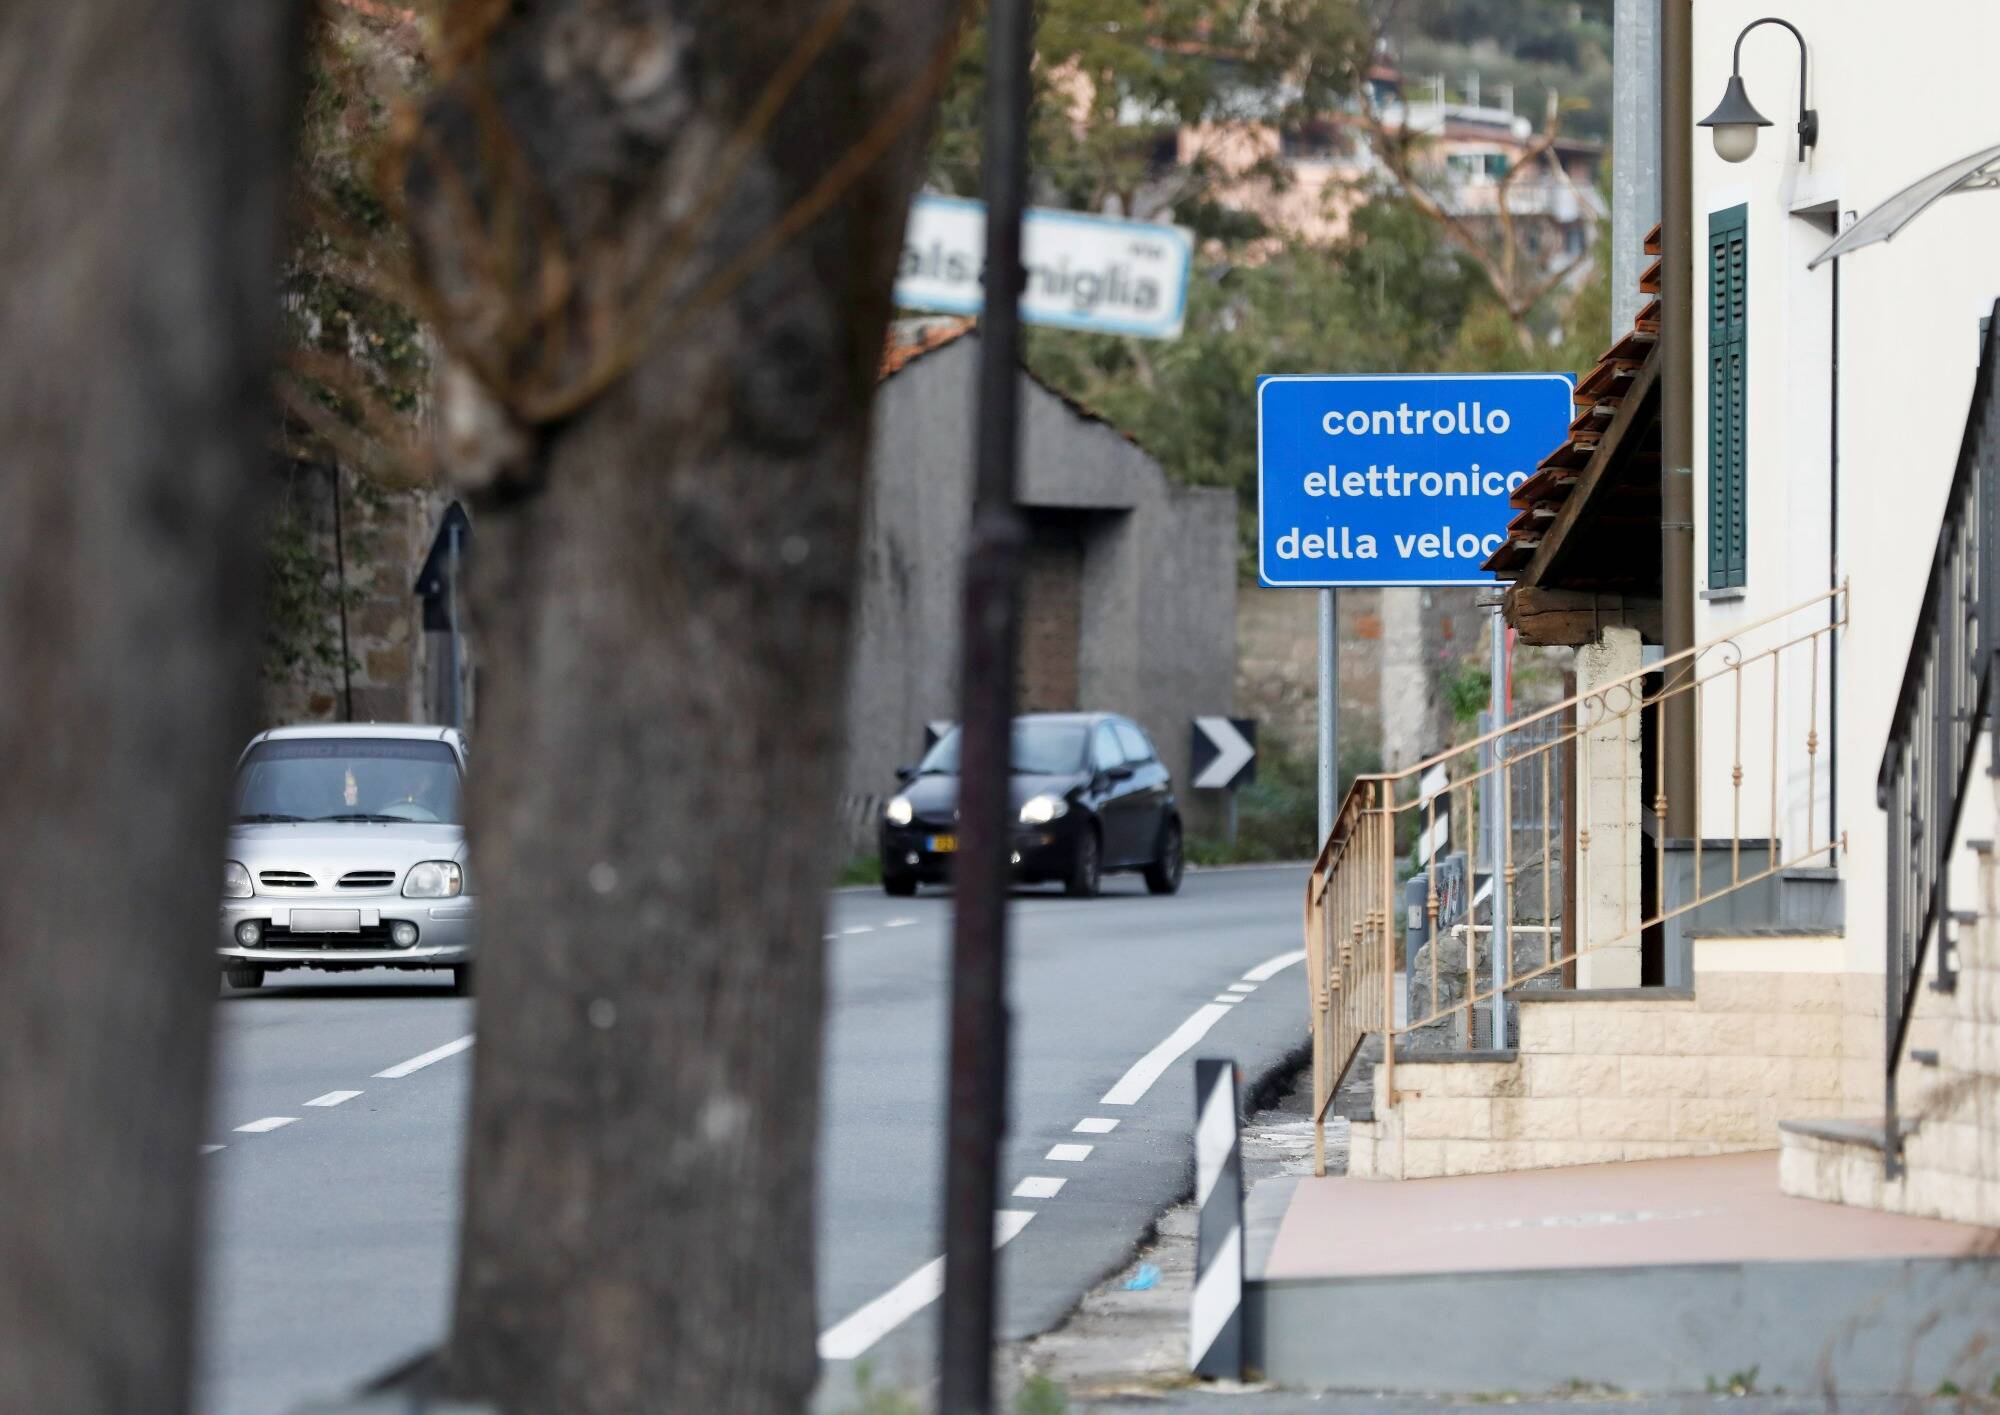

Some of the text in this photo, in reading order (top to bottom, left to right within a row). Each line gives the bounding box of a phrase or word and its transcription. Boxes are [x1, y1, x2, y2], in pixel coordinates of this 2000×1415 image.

[1322, 402, 1511, 435] controllo
[1303, 463, 1529, 497] elettronico
[1276, 526, 1508, 559] della veloc
